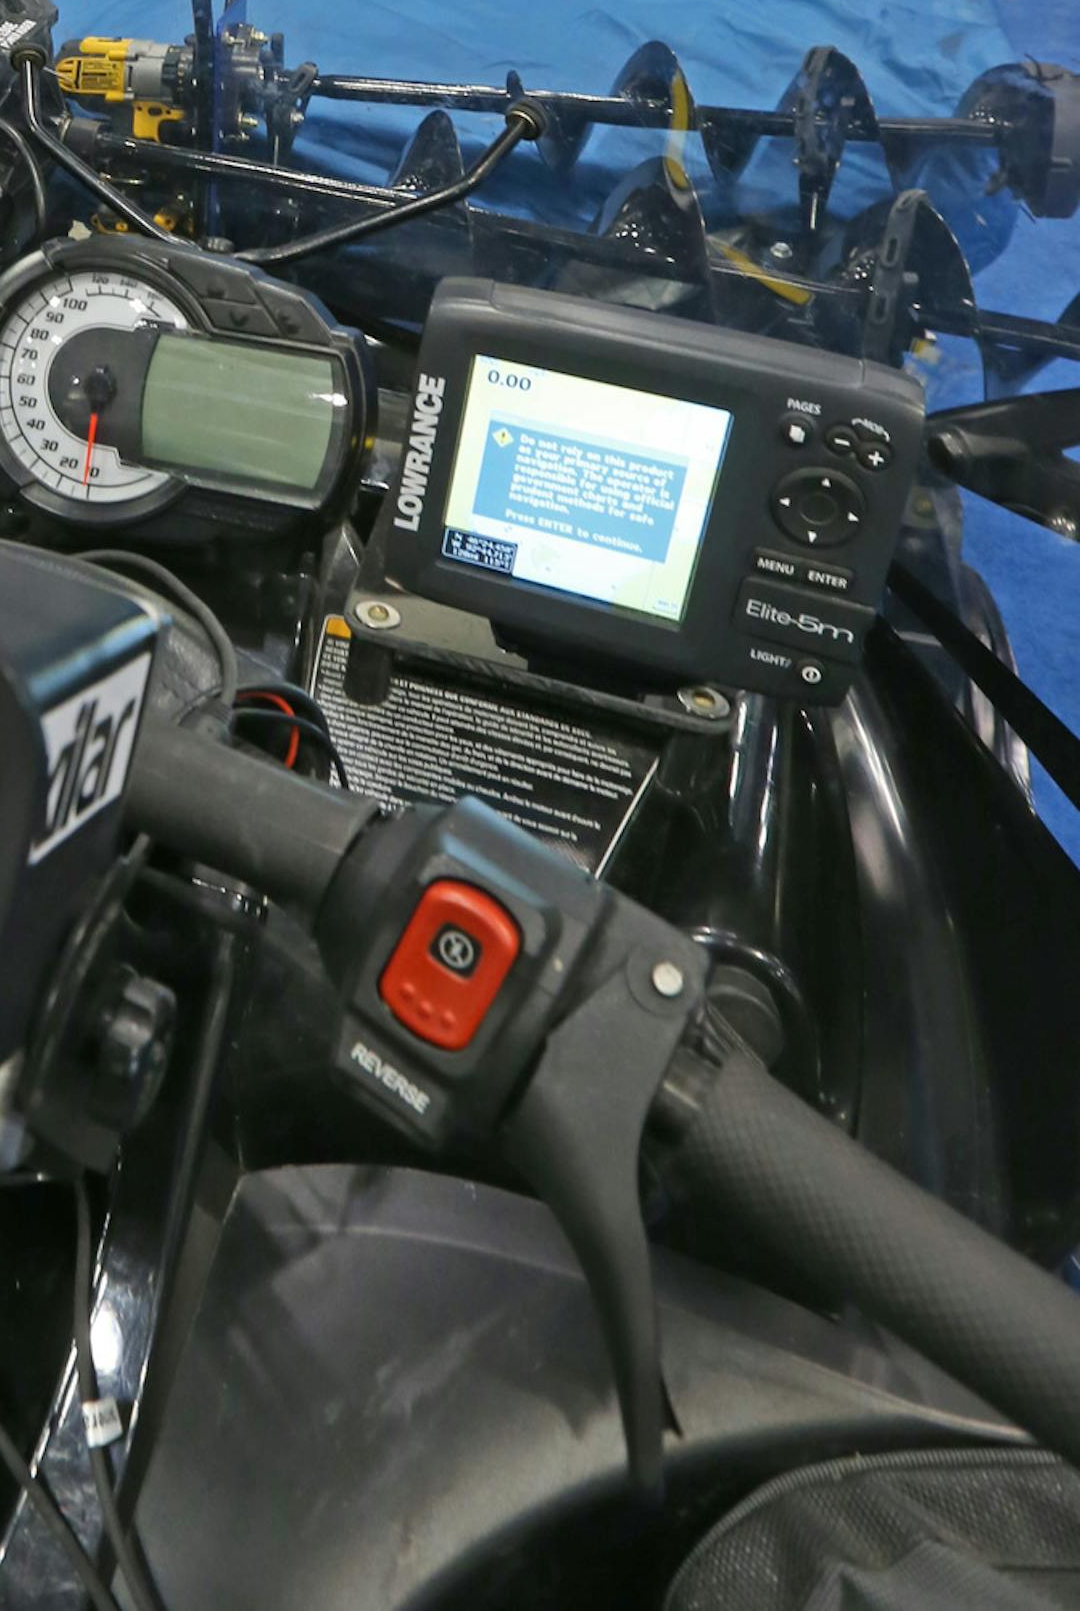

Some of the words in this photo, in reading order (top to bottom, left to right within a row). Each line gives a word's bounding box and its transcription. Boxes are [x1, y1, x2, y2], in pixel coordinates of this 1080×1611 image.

[63, 297, 88, 312] 100
[46, 311, 66, 325] 90
[30, 328, 50, 342] 80
[21, 348, 40, 361] 70
[17, 373, 37, 386] 60
[487, 369, 532, 391] 0.00
[18, 395, 38, 409] 50
[786, 397, 821, 416] PAGES
[26, 419, 46, 432] 40
[40, 439, 60, 453] 30
[519, 432, 537, 446] Do
[536, 437, 559, 452] not
[393, 373, 446, 532] LOWRANCE
[59, 457, 79, 471] 20
[576, 526, 590, 539] to
[756, 556, 795, 576] MENU
[807, 569, 848, 589] ENTER
[745, 598, 855, 644] Elite-5m
[350, 1041, 431, 1115] REVERSE
